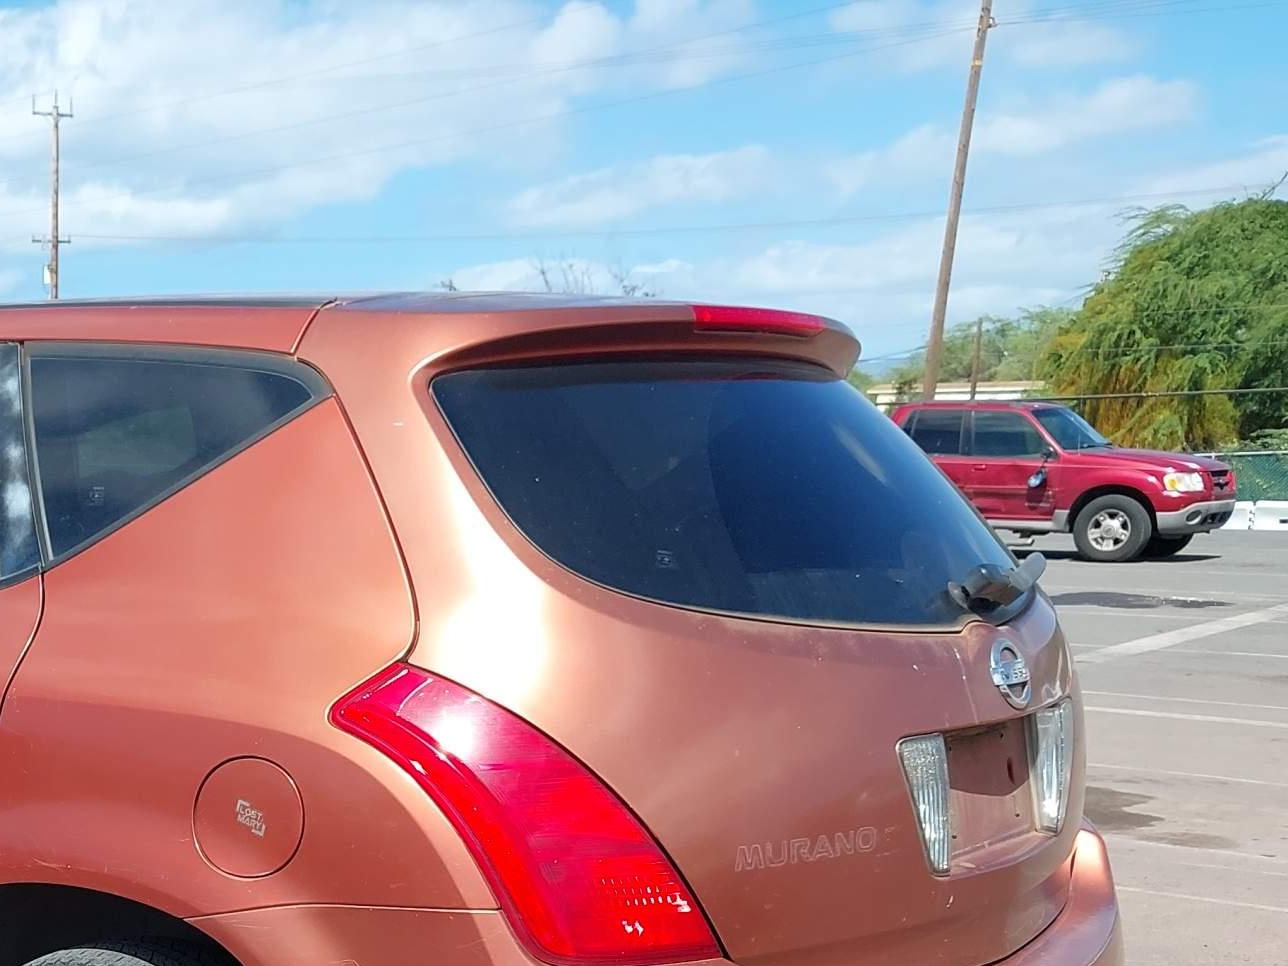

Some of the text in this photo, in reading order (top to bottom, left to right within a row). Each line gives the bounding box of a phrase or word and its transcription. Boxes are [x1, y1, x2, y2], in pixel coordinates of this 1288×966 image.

[239, 804, 263, 821] LOST
[237, 813, 262, 831] MARY
[734, 826, 878, 873] MURANO
